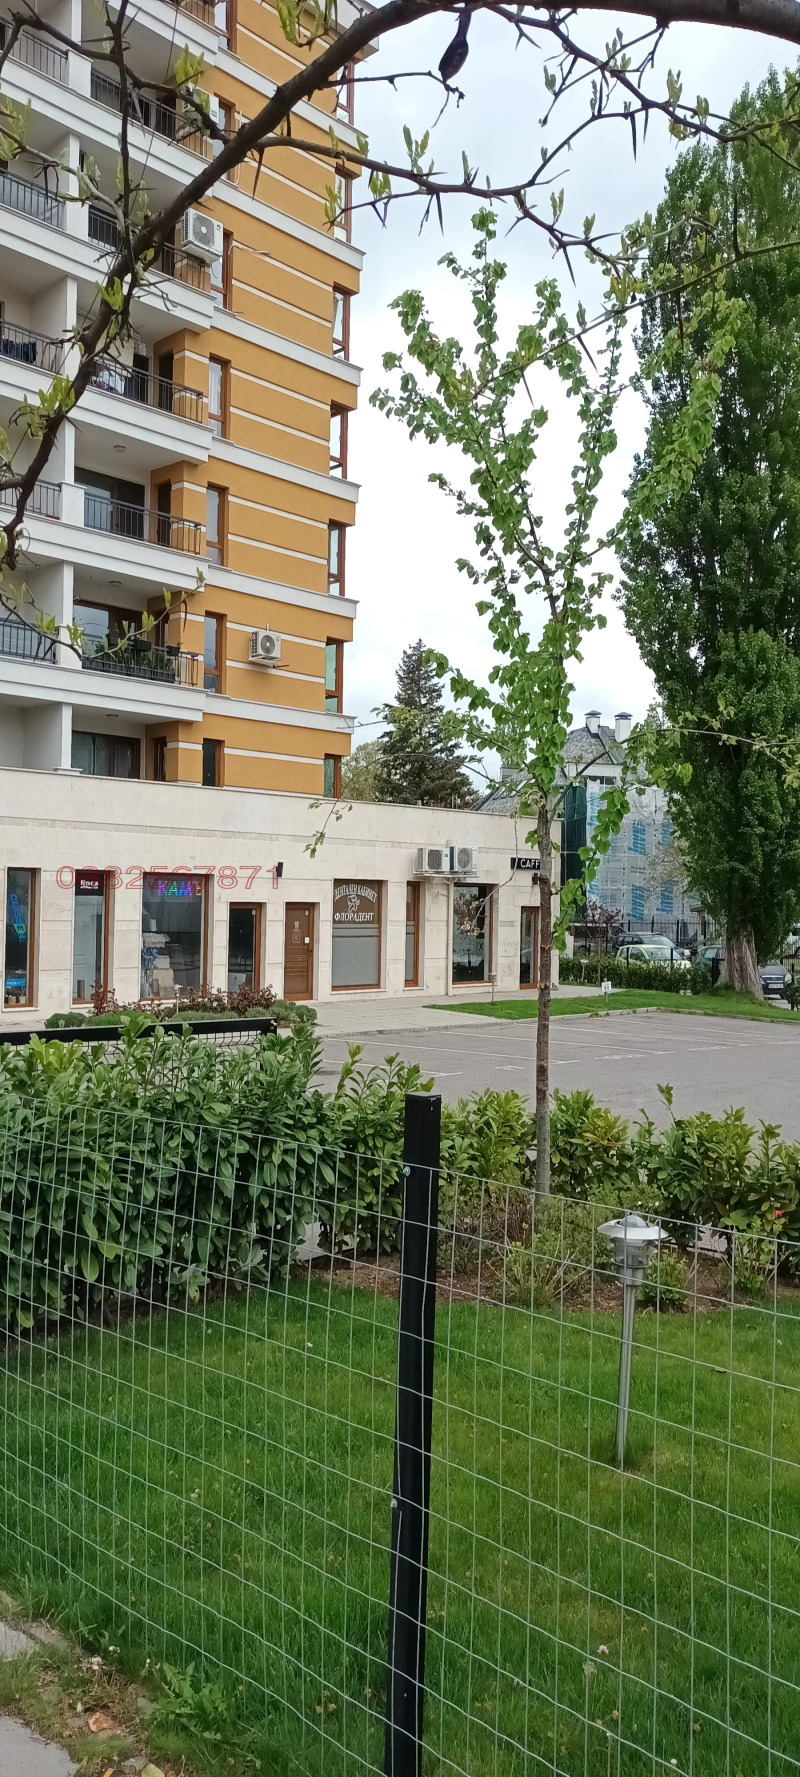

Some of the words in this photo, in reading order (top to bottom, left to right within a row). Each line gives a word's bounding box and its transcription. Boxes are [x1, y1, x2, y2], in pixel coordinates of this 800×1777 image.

[520, 858, 540, 868] CAFF
[80, 879, 99, 888] Roca
[334, 912, 374, 922] ФЛОРАДЕНТ
